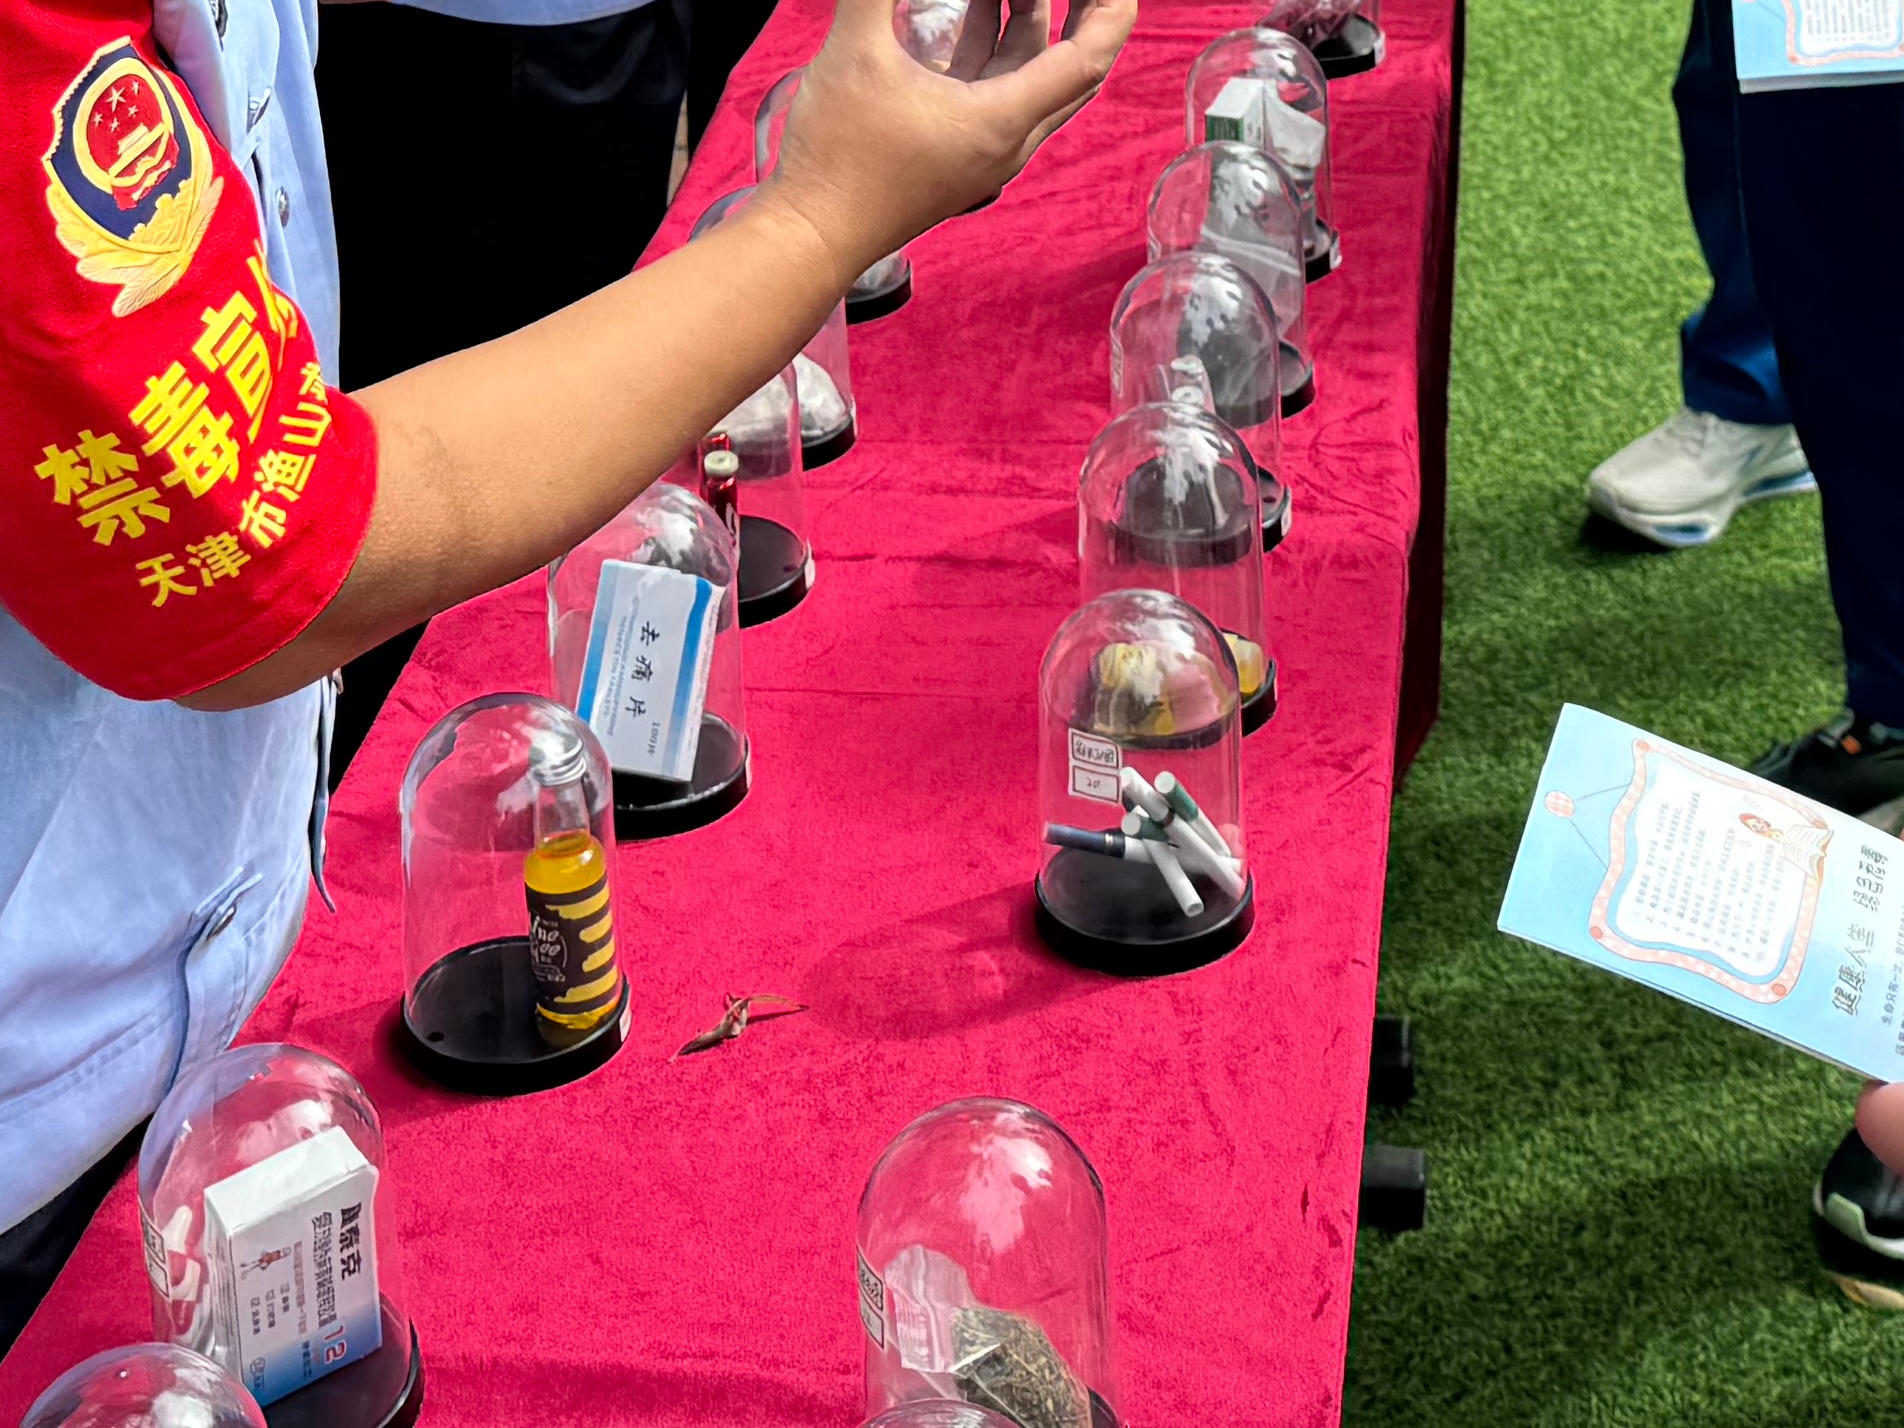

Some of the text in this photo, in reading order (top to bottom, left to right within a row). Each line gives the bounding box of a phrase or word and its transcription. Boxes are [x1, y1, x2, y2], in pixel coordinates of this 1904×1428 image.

[625, 621, 660, 720] 去痛片
[324, 1325, 347, 1365] 12
